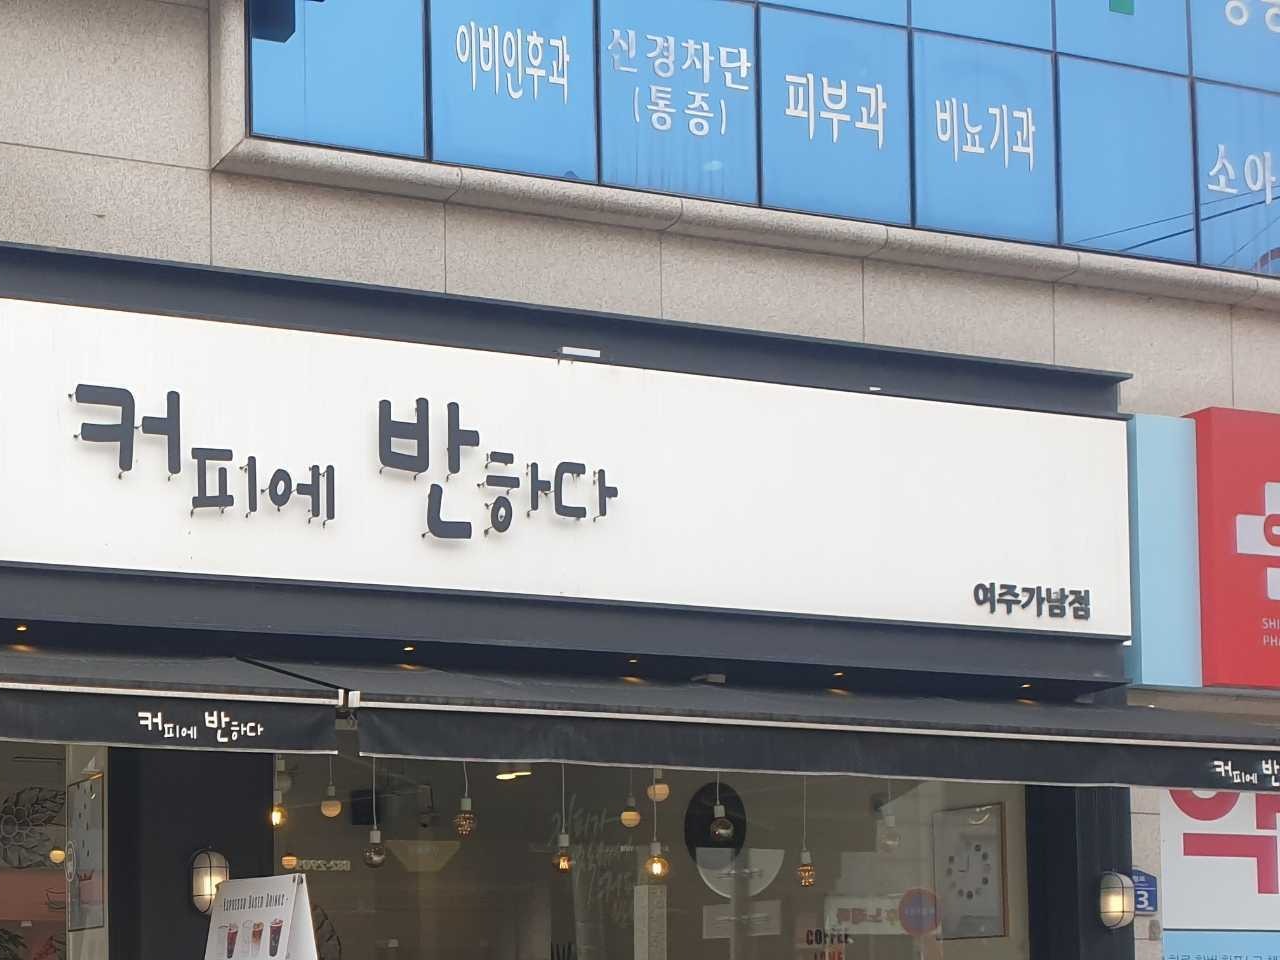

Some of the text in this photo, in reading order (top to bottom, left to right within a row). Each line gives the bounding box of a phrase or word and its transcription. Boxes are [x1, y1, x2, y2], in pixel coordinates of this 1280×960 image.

[455, 21, 570, 103] 이비인후과
[608, 27, 752, 91] 신경차단
[633, 85, 727, 137] (통증)
[784, 71, 886, 149] 피부과
[935, 97, 1036, 172] 비뇨기과
[1207, 144, 1277, 206] 소아
[74, 382, 619, 539] 커피에 반하다
[973, 582, 1091, 621] 여주가남점
[1263, 634, 1280, 647] PH
[138, 709, 264, 743] 커피에 반하다
[1213, 760, 1258, 785] 커피에
